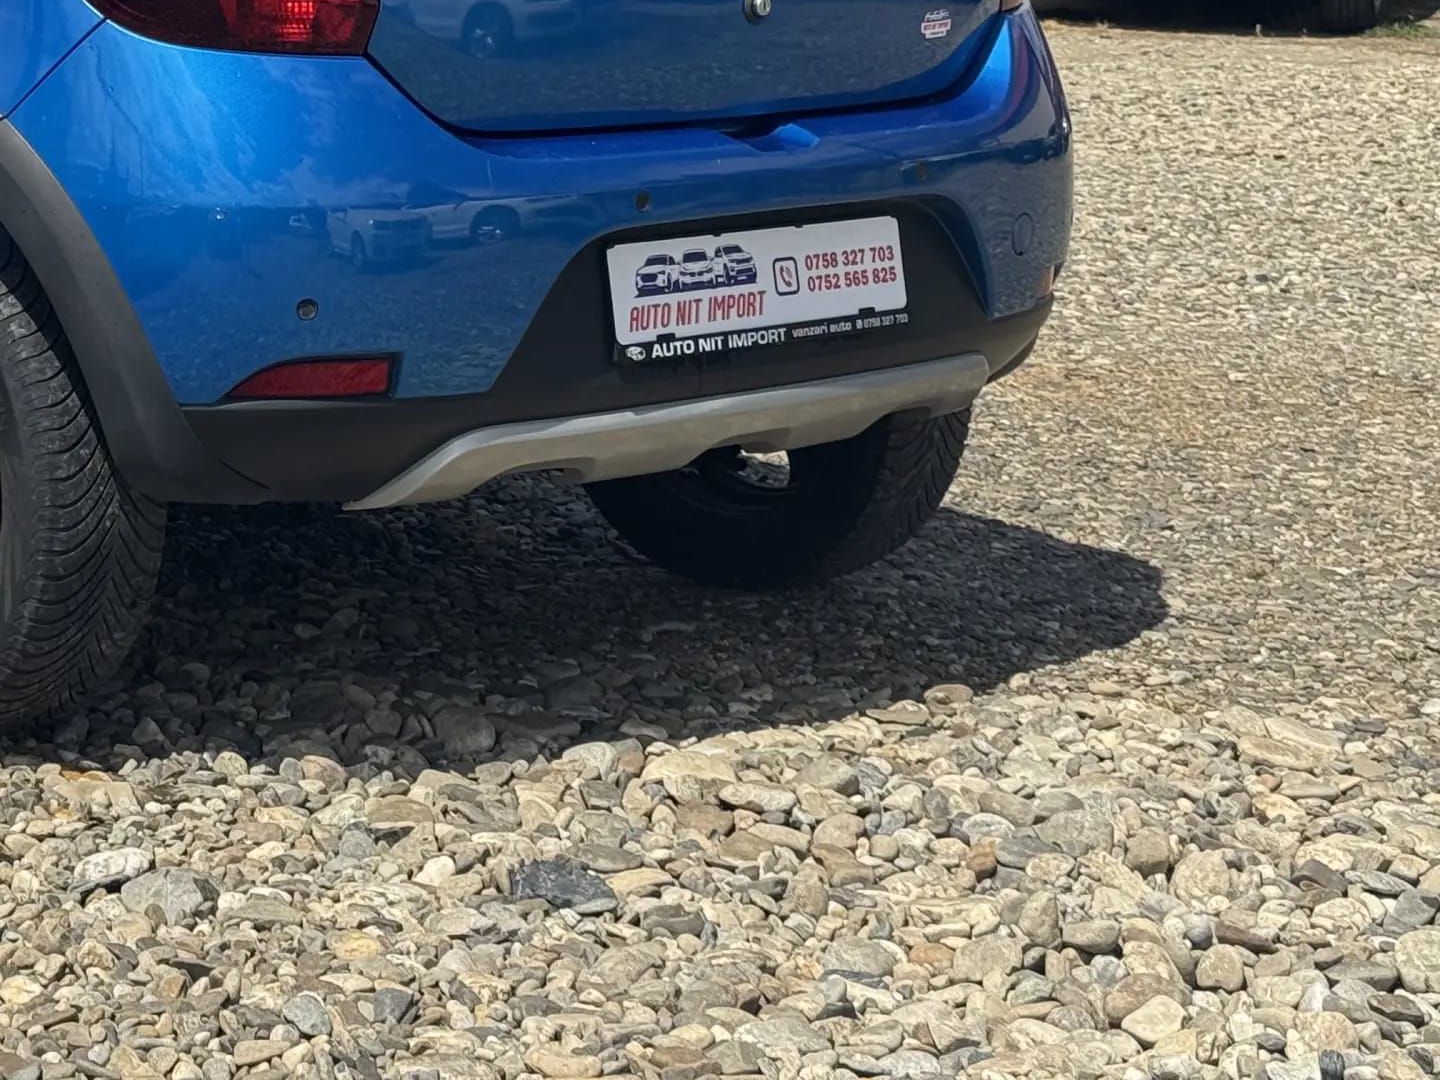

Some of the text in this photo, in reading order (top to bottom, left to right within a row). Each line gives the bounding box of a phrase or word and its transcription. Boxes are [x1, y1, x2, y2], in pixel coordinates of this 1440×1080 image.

[804, 245, 895, 271] 0758 327 703
[807, 266, 897, 292] 0752 565 825
[629, 290, 767, 332] AUTO NIT IMPORT
[651, 340, 695, 359] AUTO
[698, 336, 724, 353] NIT
[728, 328, 787, 349] IMPORT
[829, 322, 852, 333] auto
